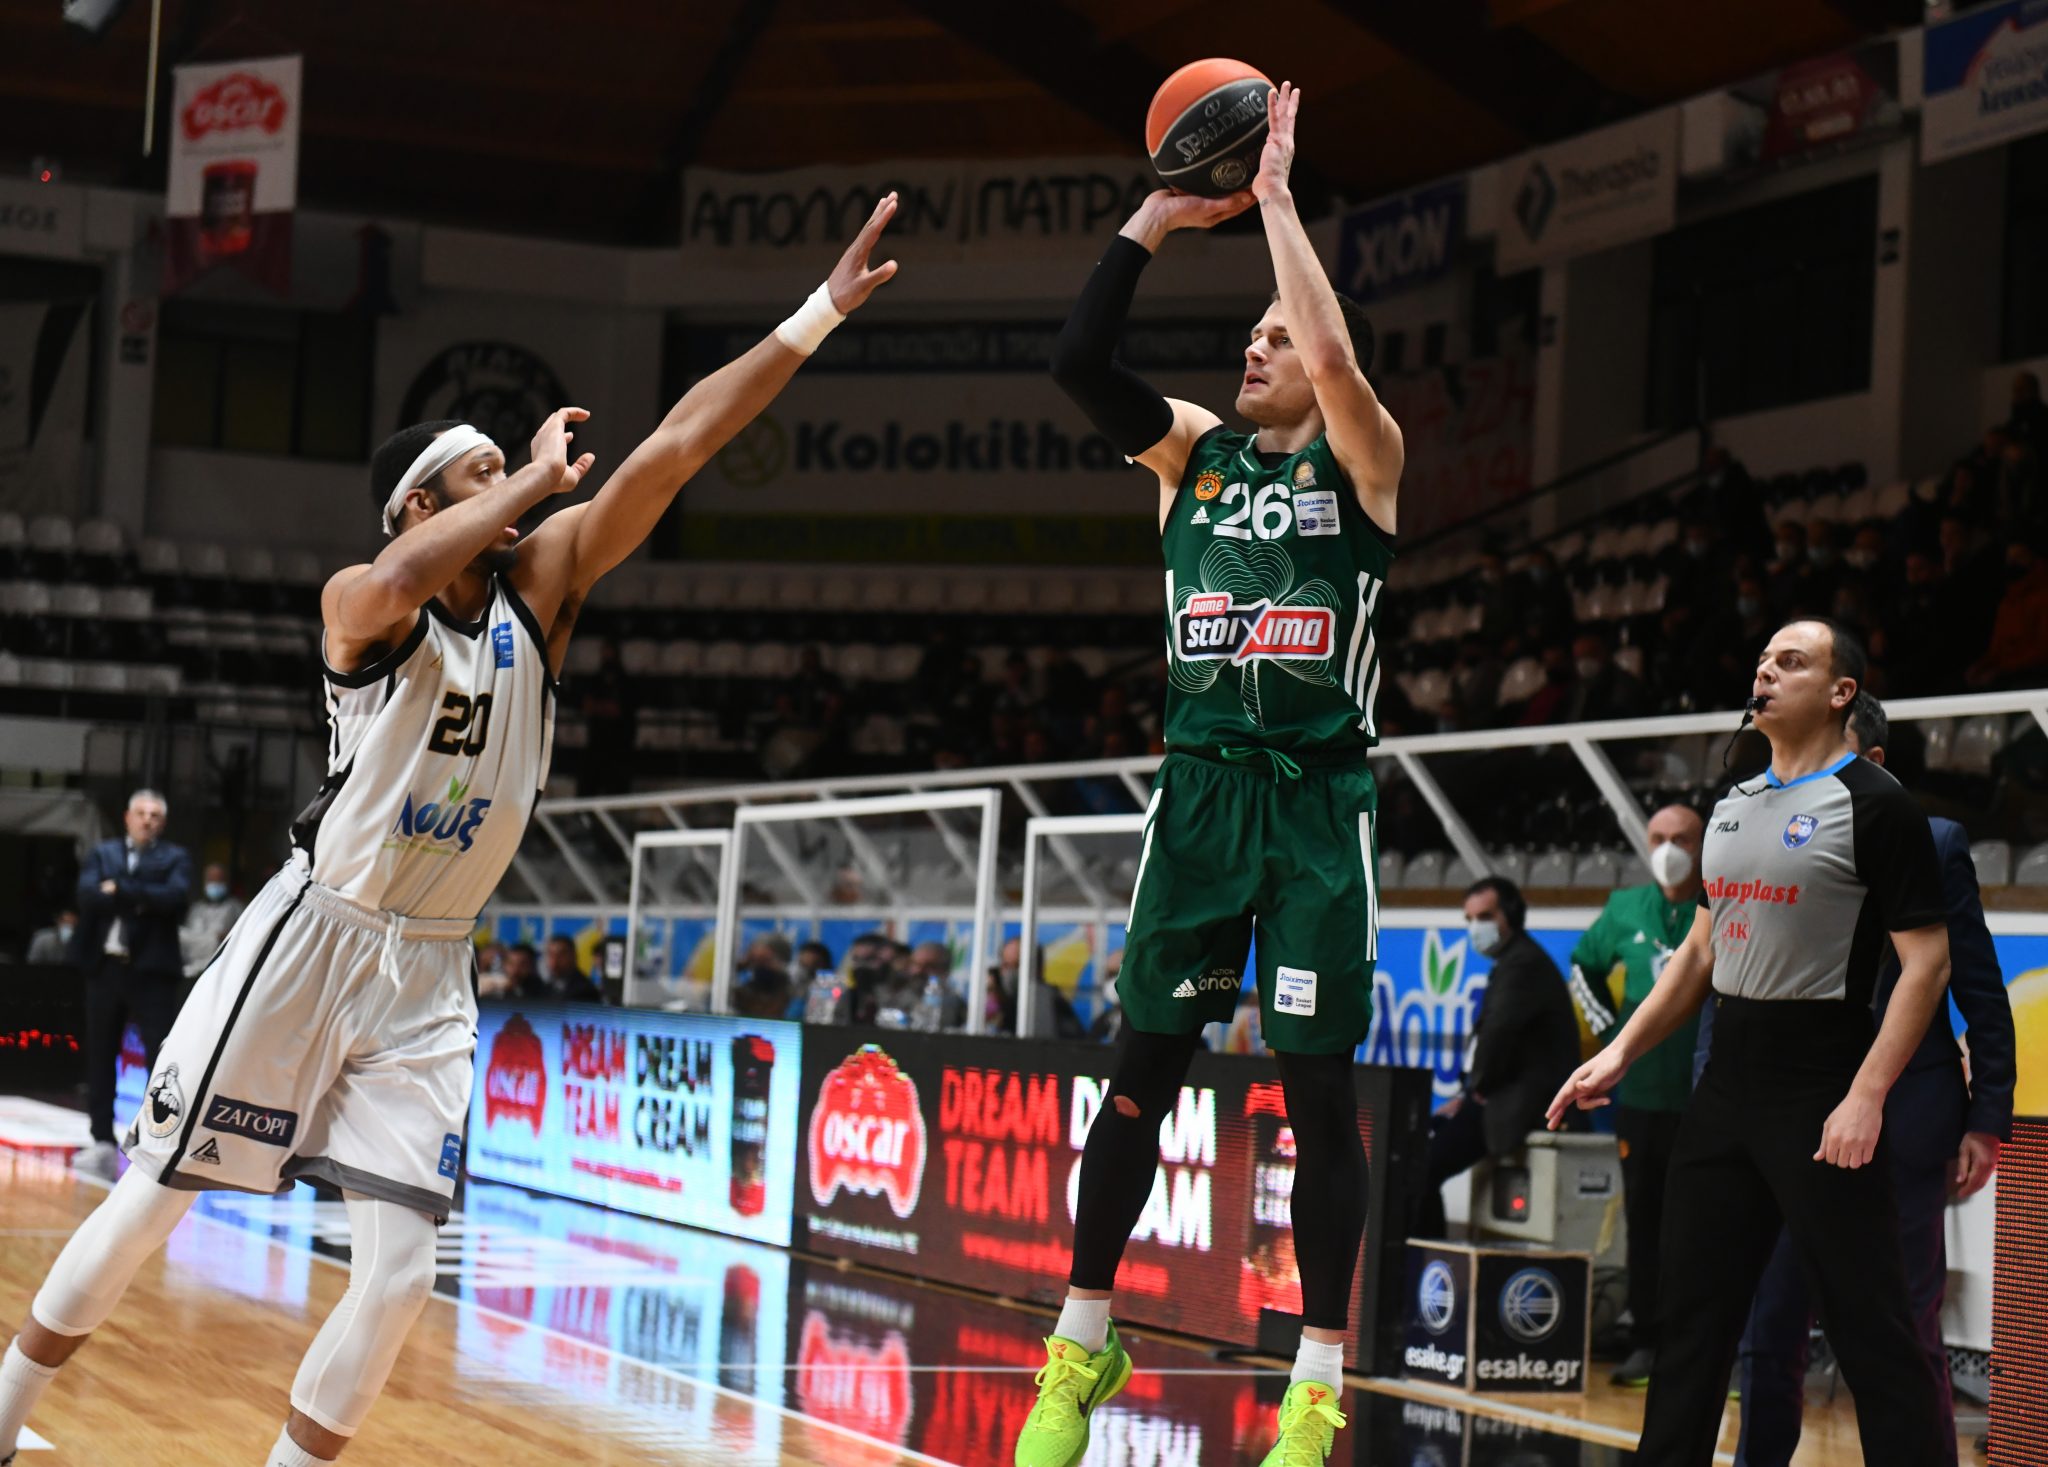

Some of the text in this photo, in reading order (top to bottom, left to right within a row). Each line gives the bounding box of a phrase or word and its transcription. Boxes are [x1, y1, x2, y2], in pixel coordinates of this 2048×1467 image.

[1176, 89, 1267, 163] SPALDING
[796, 420, 1134, 472] Kolokitha
[1213, 482, 1293, 541] 26
[1193, 599, 1224, 615] pame
[427, 691, 493, 757] 20
[1714, 821, 1740, 834] FILA
[940, 1065, 1060, 1146] DREAM
[823, 1110, 911, 1169] oscar
[944, 1138, 1050, 1225] TEAM
[1405, 1343, 1466, 1381] esake.gr
[1477, 1353, 1582, 1386] esake.gr
